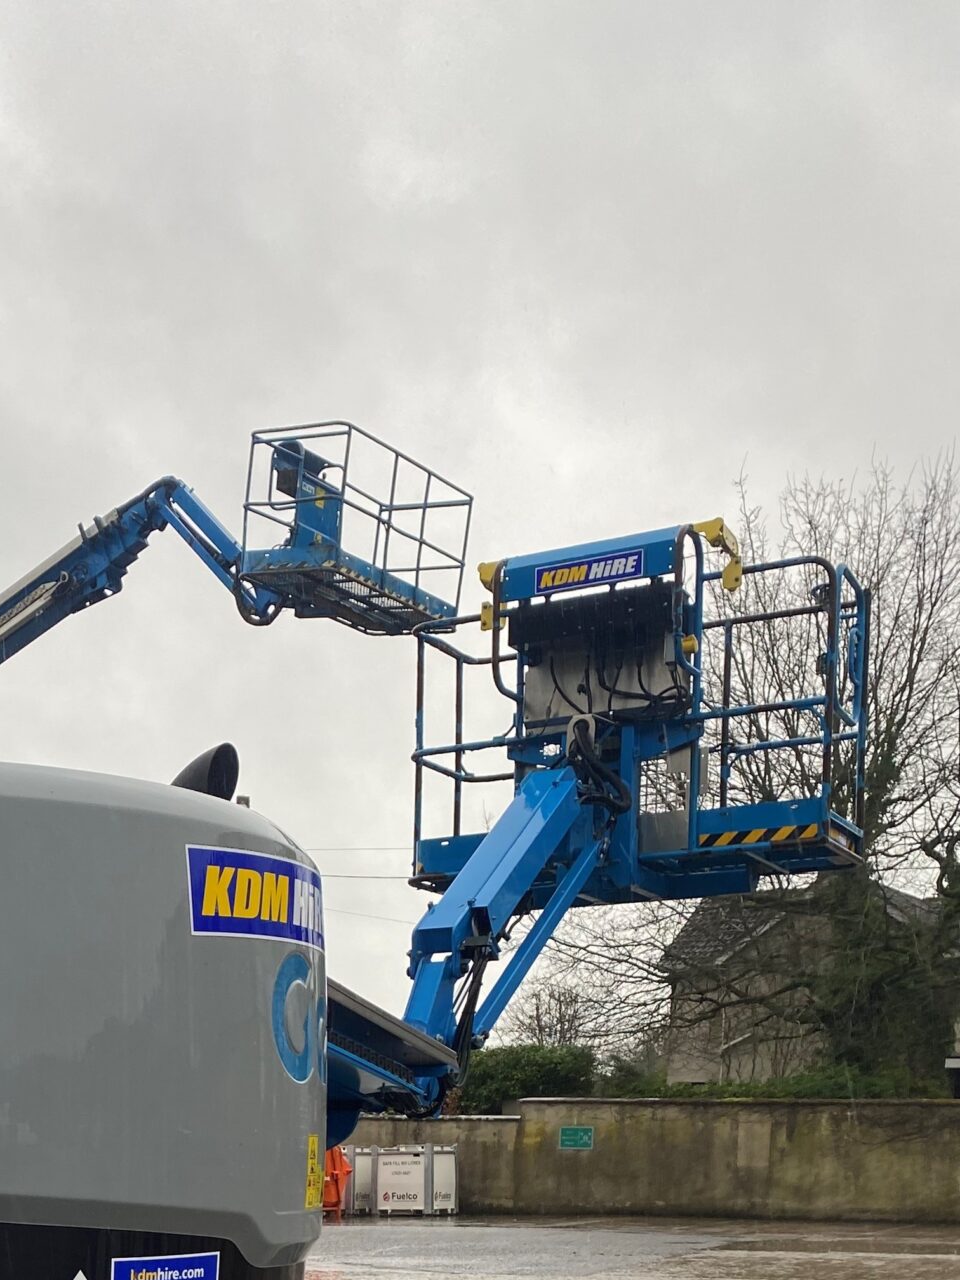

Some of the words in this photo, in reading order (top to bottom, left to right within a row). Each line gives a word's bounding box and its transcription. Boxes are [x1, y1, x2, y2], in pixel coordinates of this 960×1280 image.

[540, 564, 588, 589] KDM
[202, 864, 290, 924] KDM
[391, 1192, 418, 1200] Fuelco
